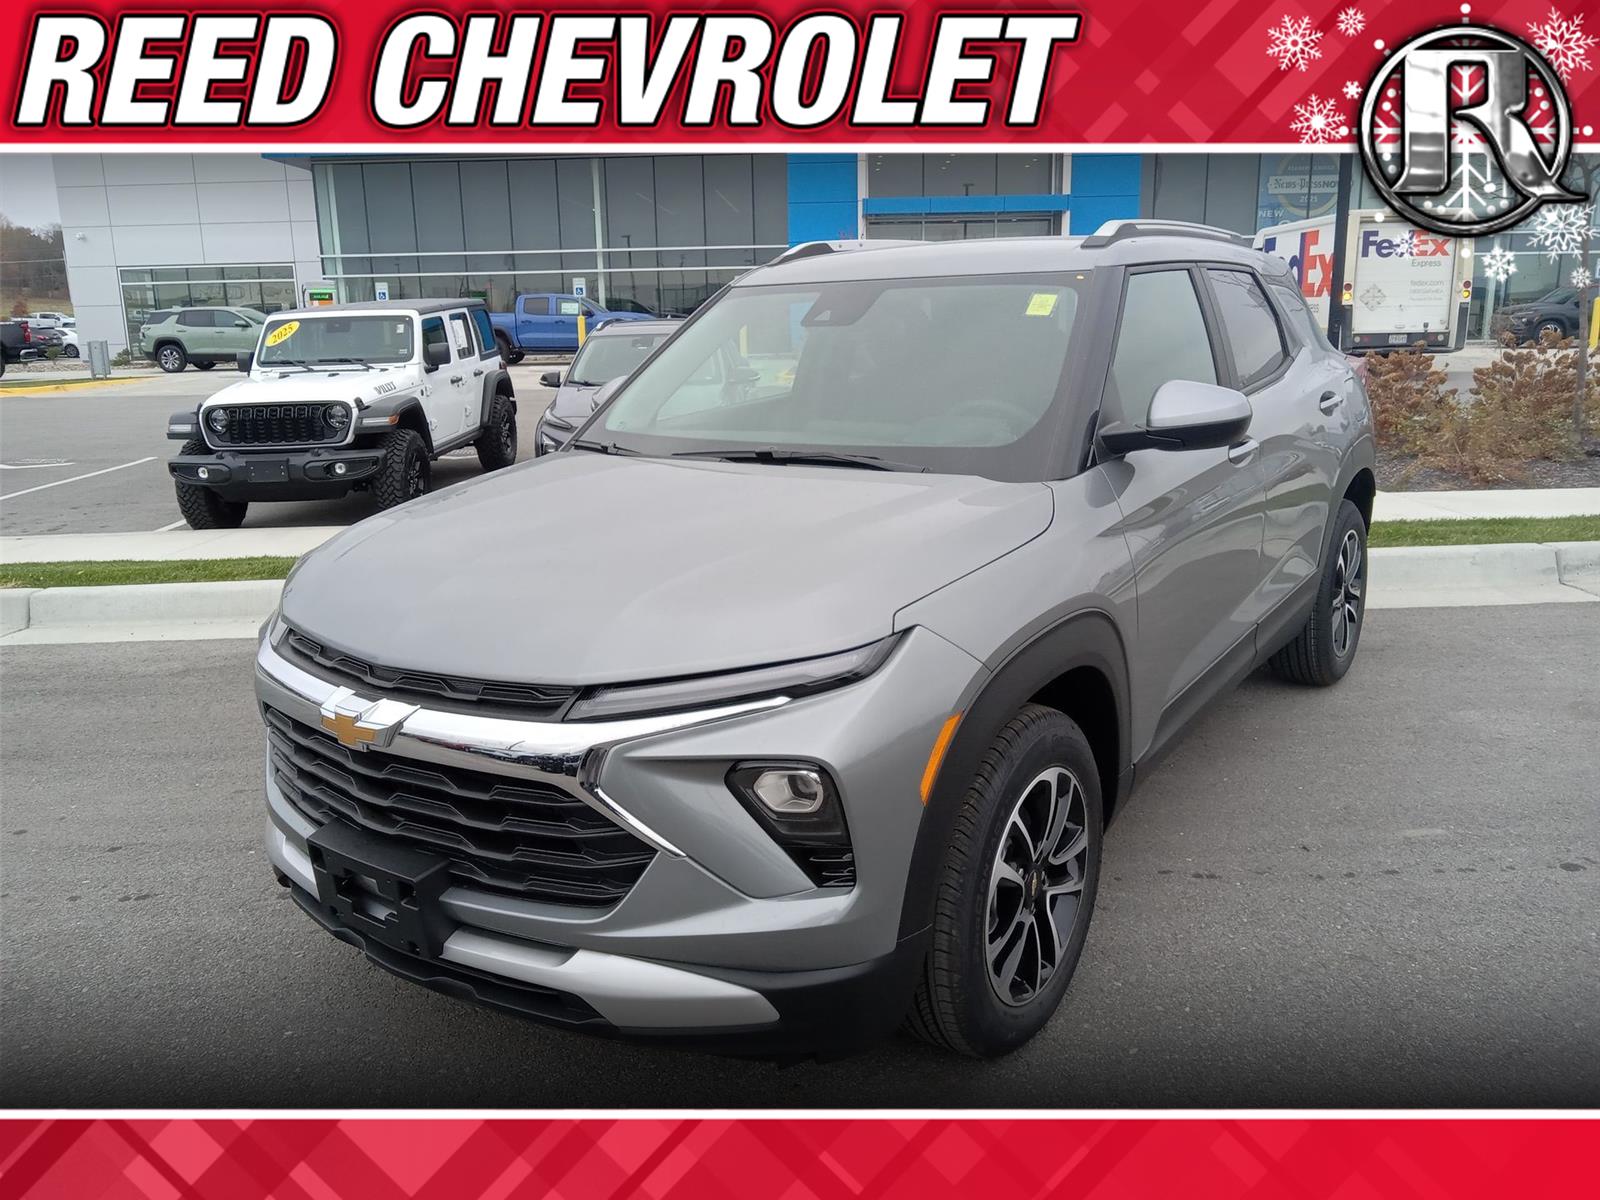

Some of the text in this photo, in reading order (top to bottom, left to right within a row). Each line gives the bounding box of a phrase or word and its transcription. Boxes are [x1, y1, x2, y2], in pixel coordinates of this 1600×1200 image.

[1259, 208, 1285, 218] NEW
[1361, 229, 1452, 258] FedEx
[1411, 258, 1442, 267] Express
[271, 323, 294, 344] 2025
